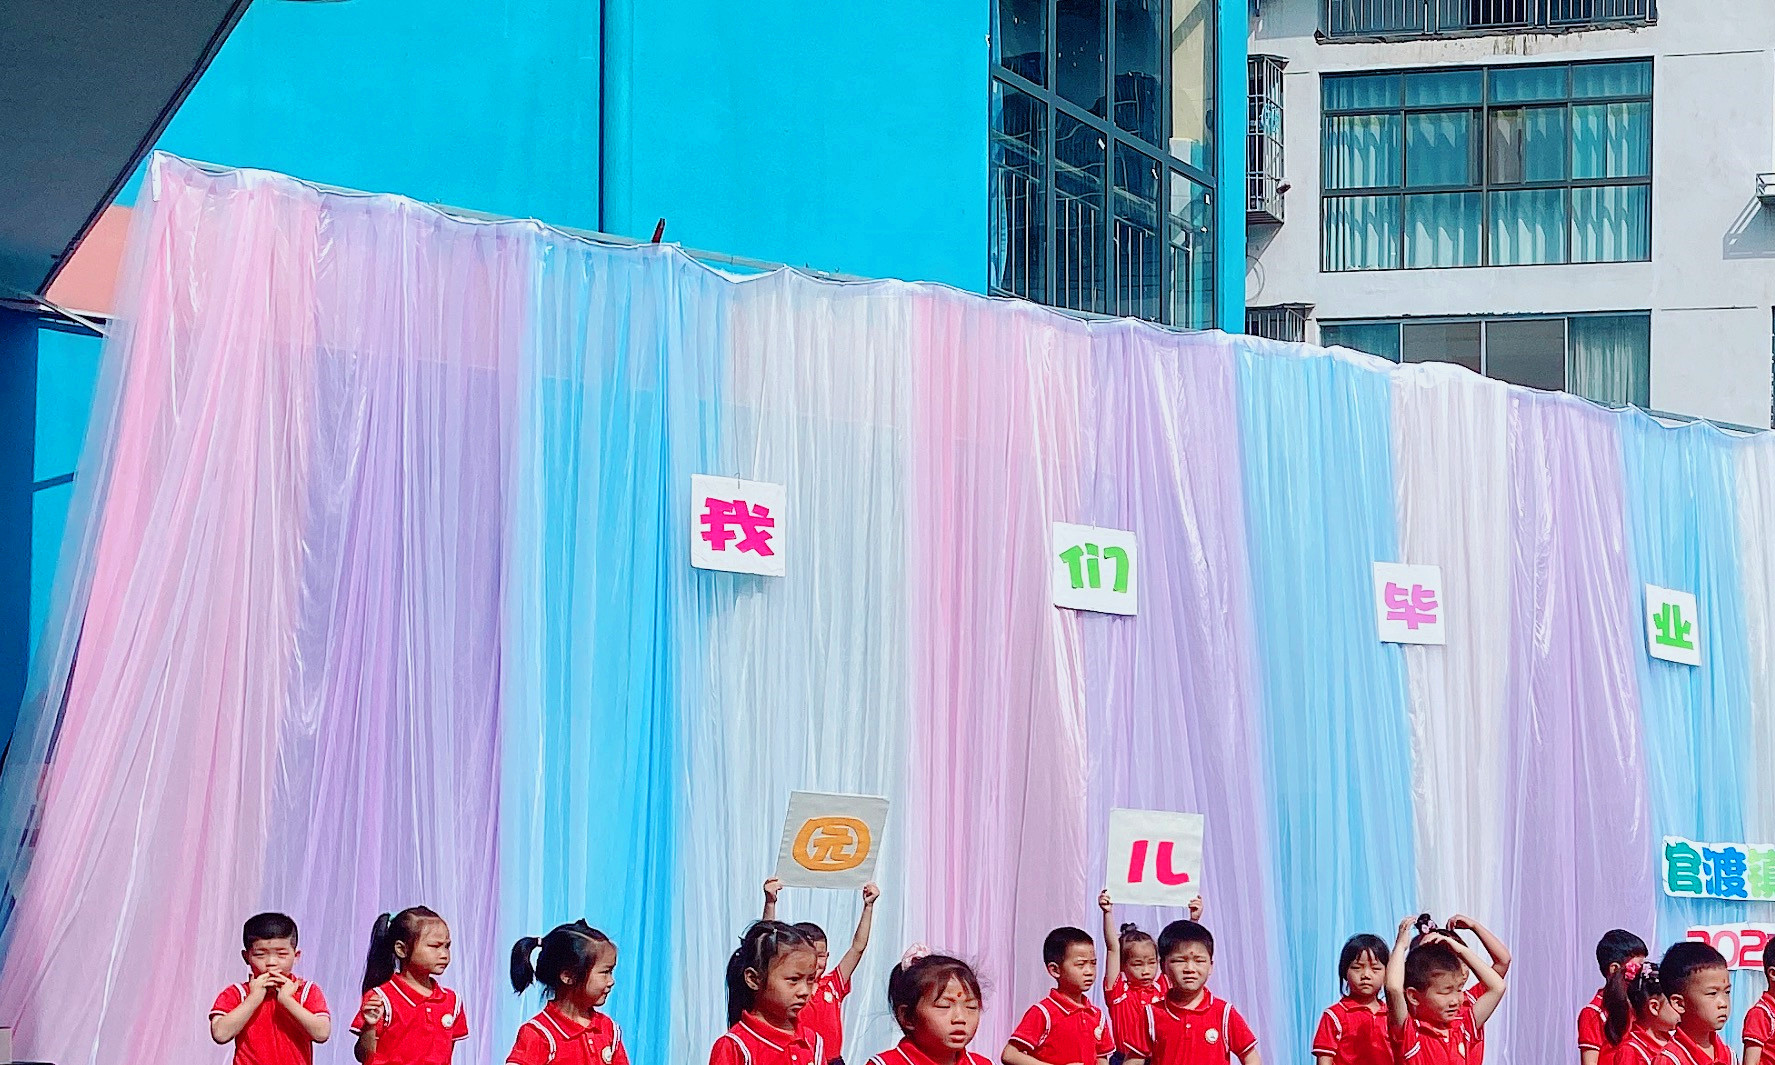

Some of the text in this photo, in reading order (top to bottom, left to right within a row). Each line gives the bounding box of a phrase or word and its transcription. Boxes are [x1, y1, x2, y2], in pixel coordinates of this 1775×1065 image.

[700, 496, 775, 556] 我
[1059, 542, 1129, 594] 们
[1385, 582, 1438, 630] 毕
[1653, 602, 1694, 650] 业
[792, 816, 871, 872] 园
[1128, 839, 1190, 886] 儿
